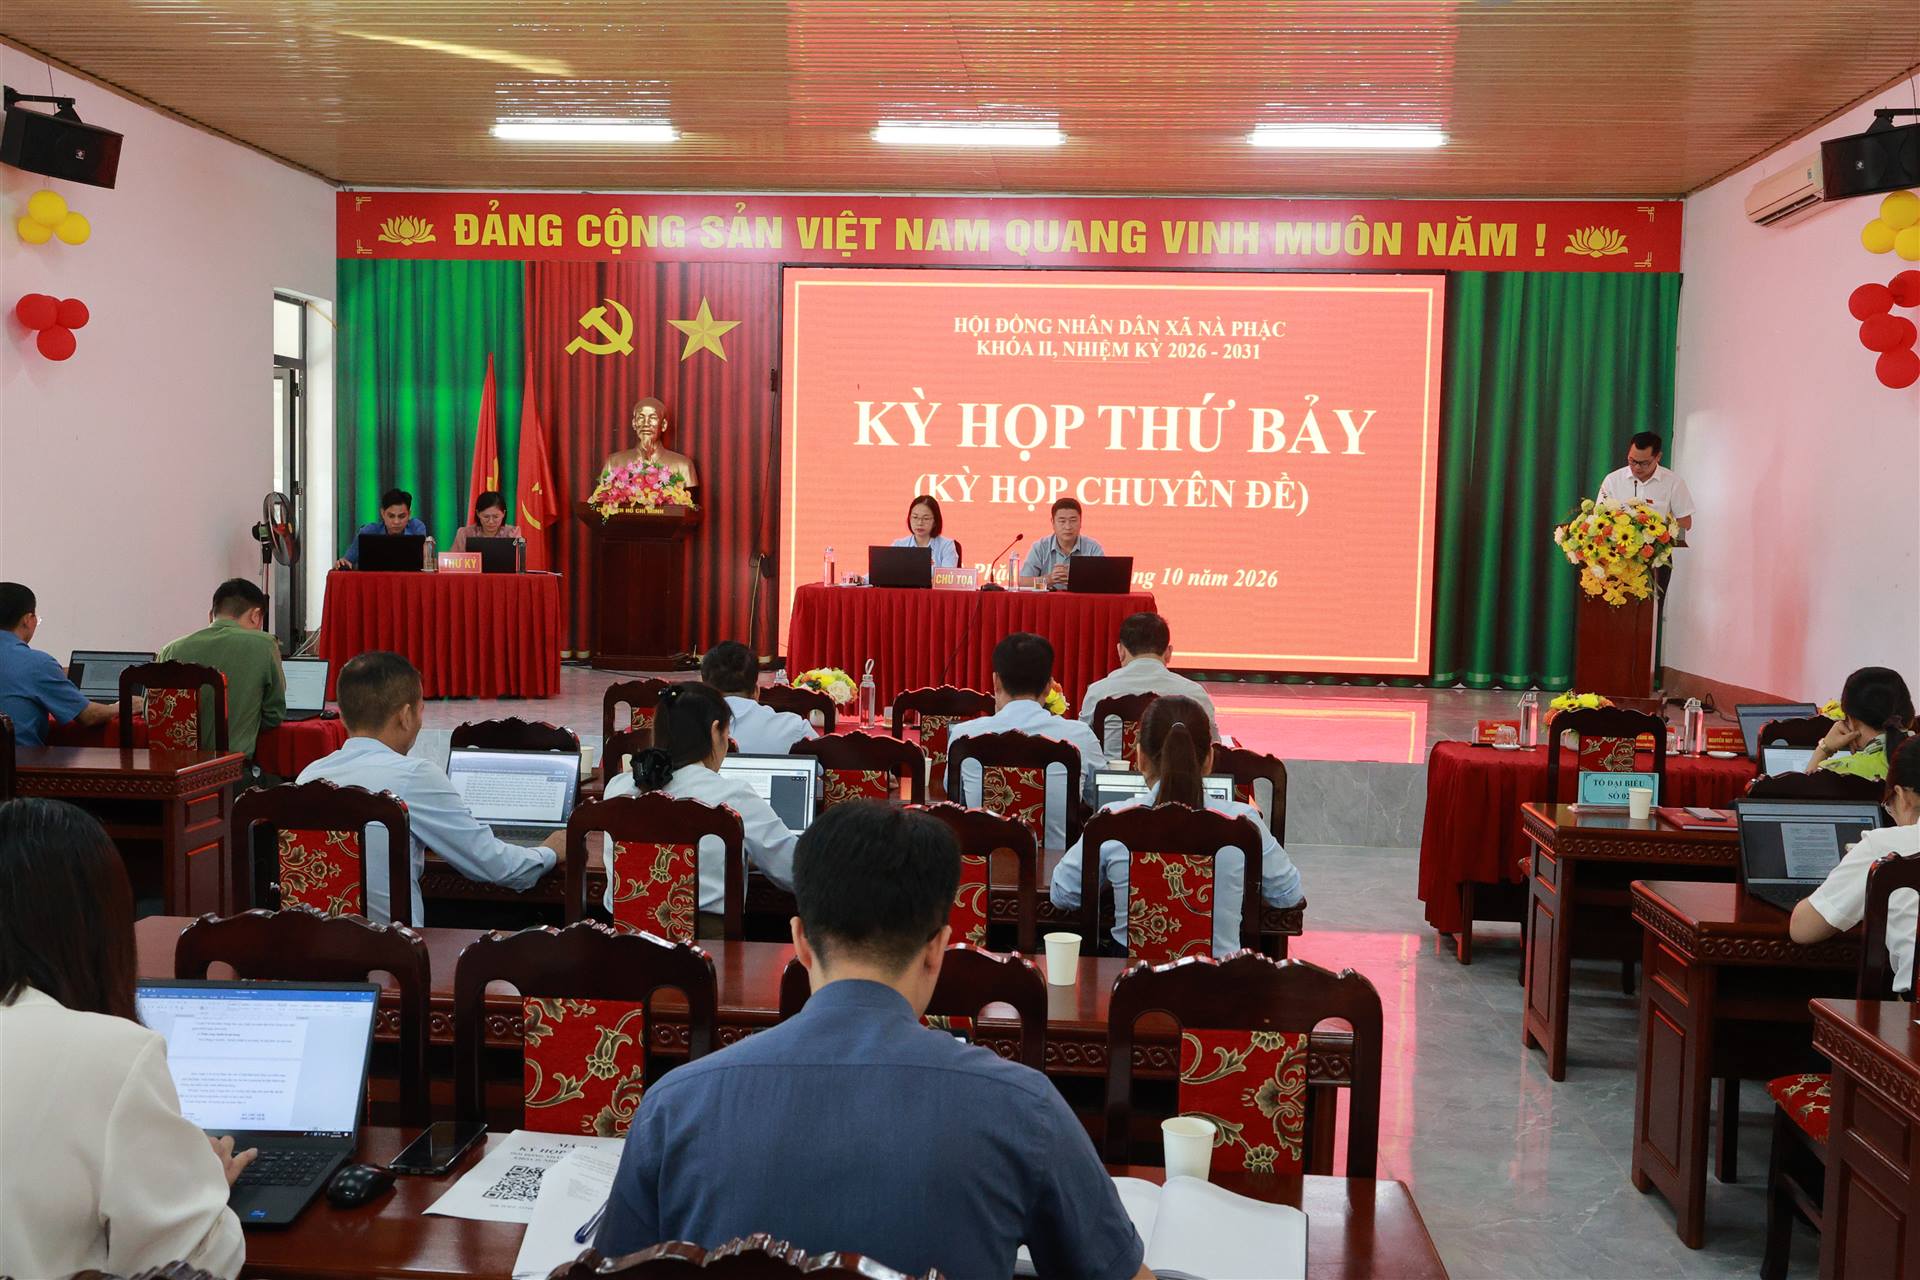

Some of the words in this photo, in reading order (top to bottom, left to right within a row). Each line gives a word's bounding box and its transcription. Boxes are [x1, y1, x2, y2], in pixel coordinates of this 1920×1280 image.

[453, 199, 563, 247] ĐẢNG
[577, 209, 686, 255] CỘNG
[701, 202, 783, 249] SẢN
[797, 211, 882, 257] VIỆT
[896, 219, 990, 252] NAM
[1006, 218, 1147, 258] QUANG
[1161, 220, 1260, 255] VINH
[1274, 214, 1402, 256] MUÔN
[1417, 215, 1518, 257] NĂM
[1534, 223, 1546, 257] !
[954, 314, 990, 338] HỘI
[995, 313, 1053, 335] ĐỒNG
[1057, 314, 1114, 336] NHÂN
[1119, 315, 1160, 337] DÂN
[1165, 316, 1193, 337] XÃ
[1198, 316, 1226, 338] NÀ
[1231, 317, 1287, 341] PHẶC
[977, 335, 1035, 357] KHÓA
[1038, 340, 1058, 359] II,
[1062, 340, 1129, 362] NHIỆM
[1134, 337, 1164, 359] KỲ
[1167, 342, 1208, 359] 2026
[1222, 343, 1261, 360] 2031
[853, 387, 942, 447] KỲ
[957, 402, 1085, 462] HỌP
[1097, 392, 1236, 453] THỨ
[1247, 393, 1378, 456] BẢY
[914, 466, 982, 503] (KỲ
[990, 474, 1069, 512] HỌP
[1076, 470, 1237, 508] CHUYÊN
[1245, 471, 1310, 517] ĐỀ)
[935, 571, 954, 585] CHỦ
[1161, 568, 1184, 586] 10
[1188, 569, 1229, 587] năm
[1233, 569, 1279, 589] 2026
